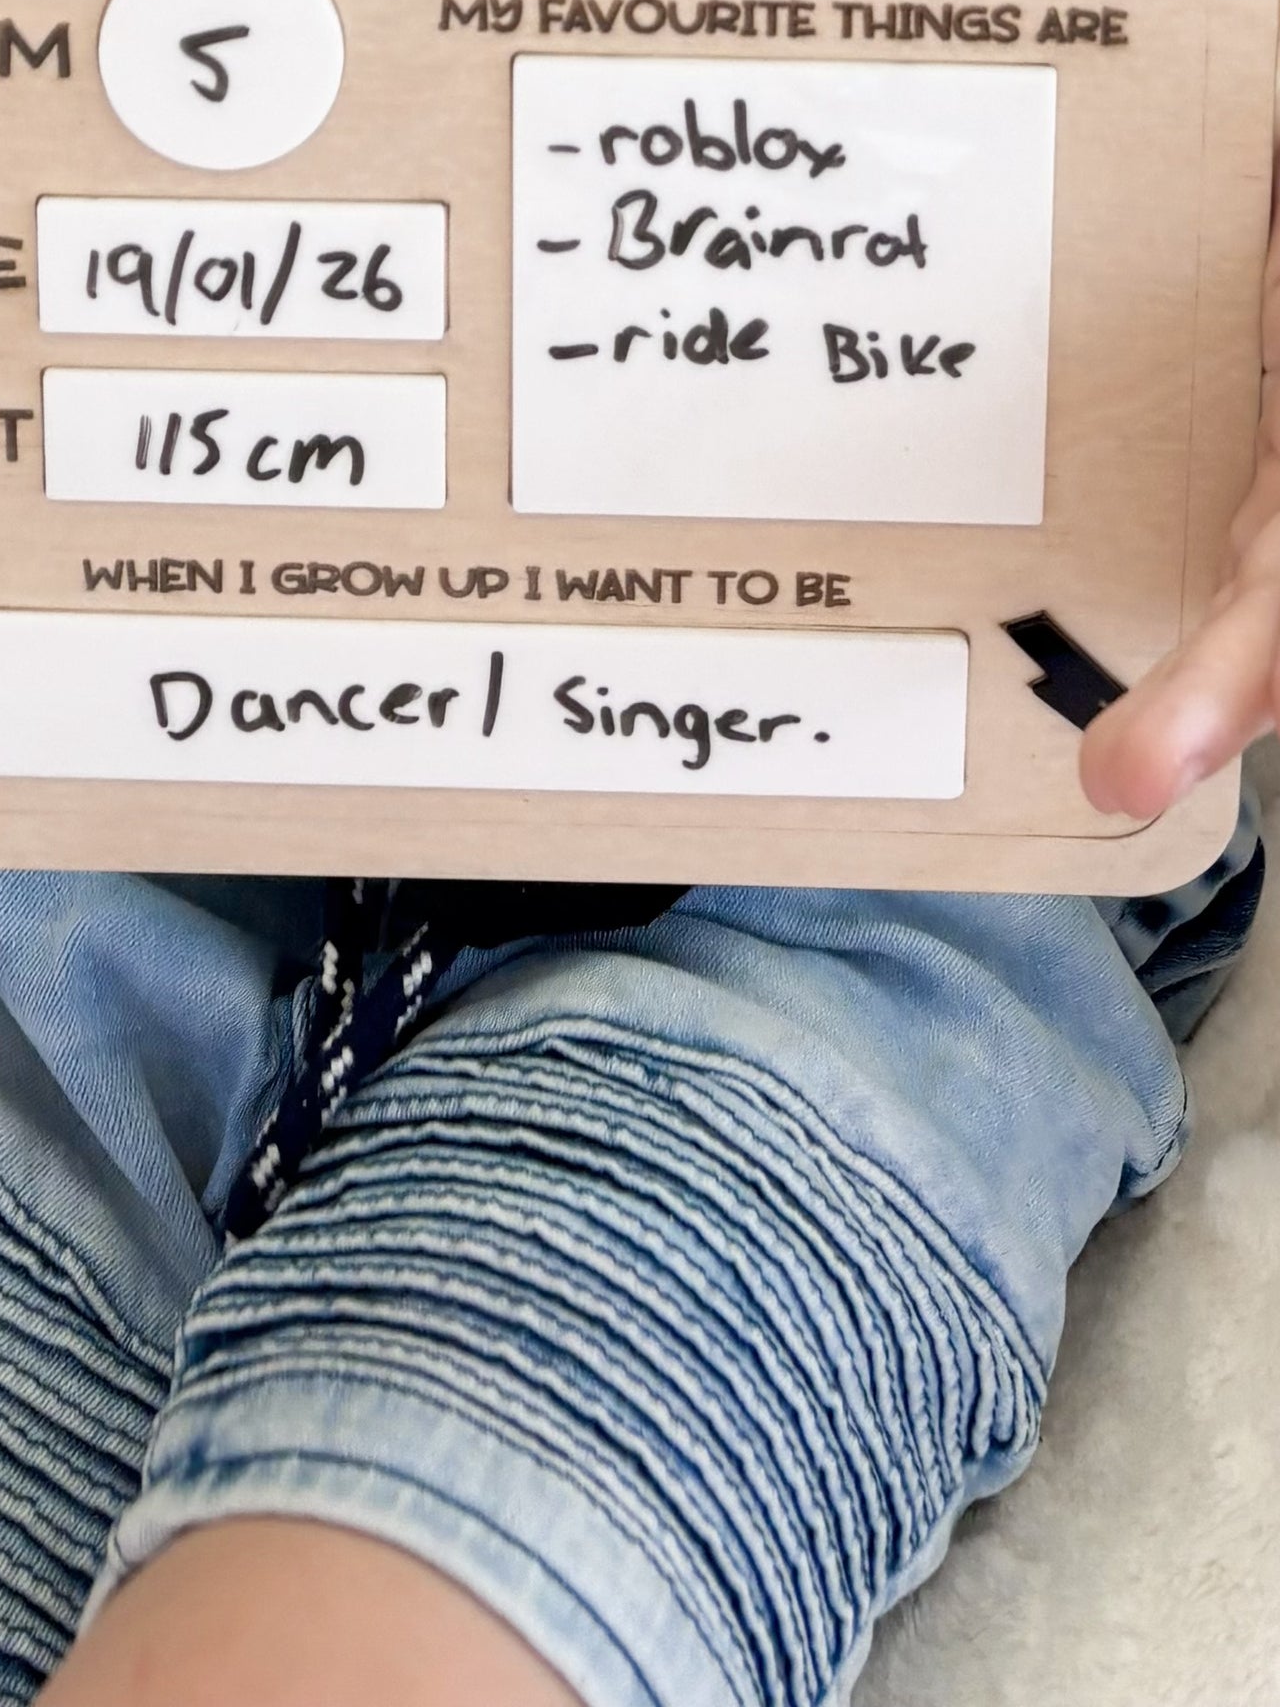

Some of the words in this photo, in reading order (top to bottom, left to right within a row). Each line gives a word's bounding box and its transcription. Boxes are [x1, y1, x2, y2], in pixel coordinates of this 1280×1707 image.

[832, 1, 1020, 45] THINGS
[1035, 7, 1129, 46] ARE
[179, 24, 250, 103] 5
[85, 221, 405, 327] 19/01/26
[80, 556, 224, 594] WHEN
[237, 560, 257, 595] I
[270, 560, 425, 598] GROW
[439, 564, 510, 600] UP
[525, 565, 543, 602] I
[555, 566, 693, 606] WANT
[713, 568, 779, 607] TO
[793, 570, 851, 609] BE
